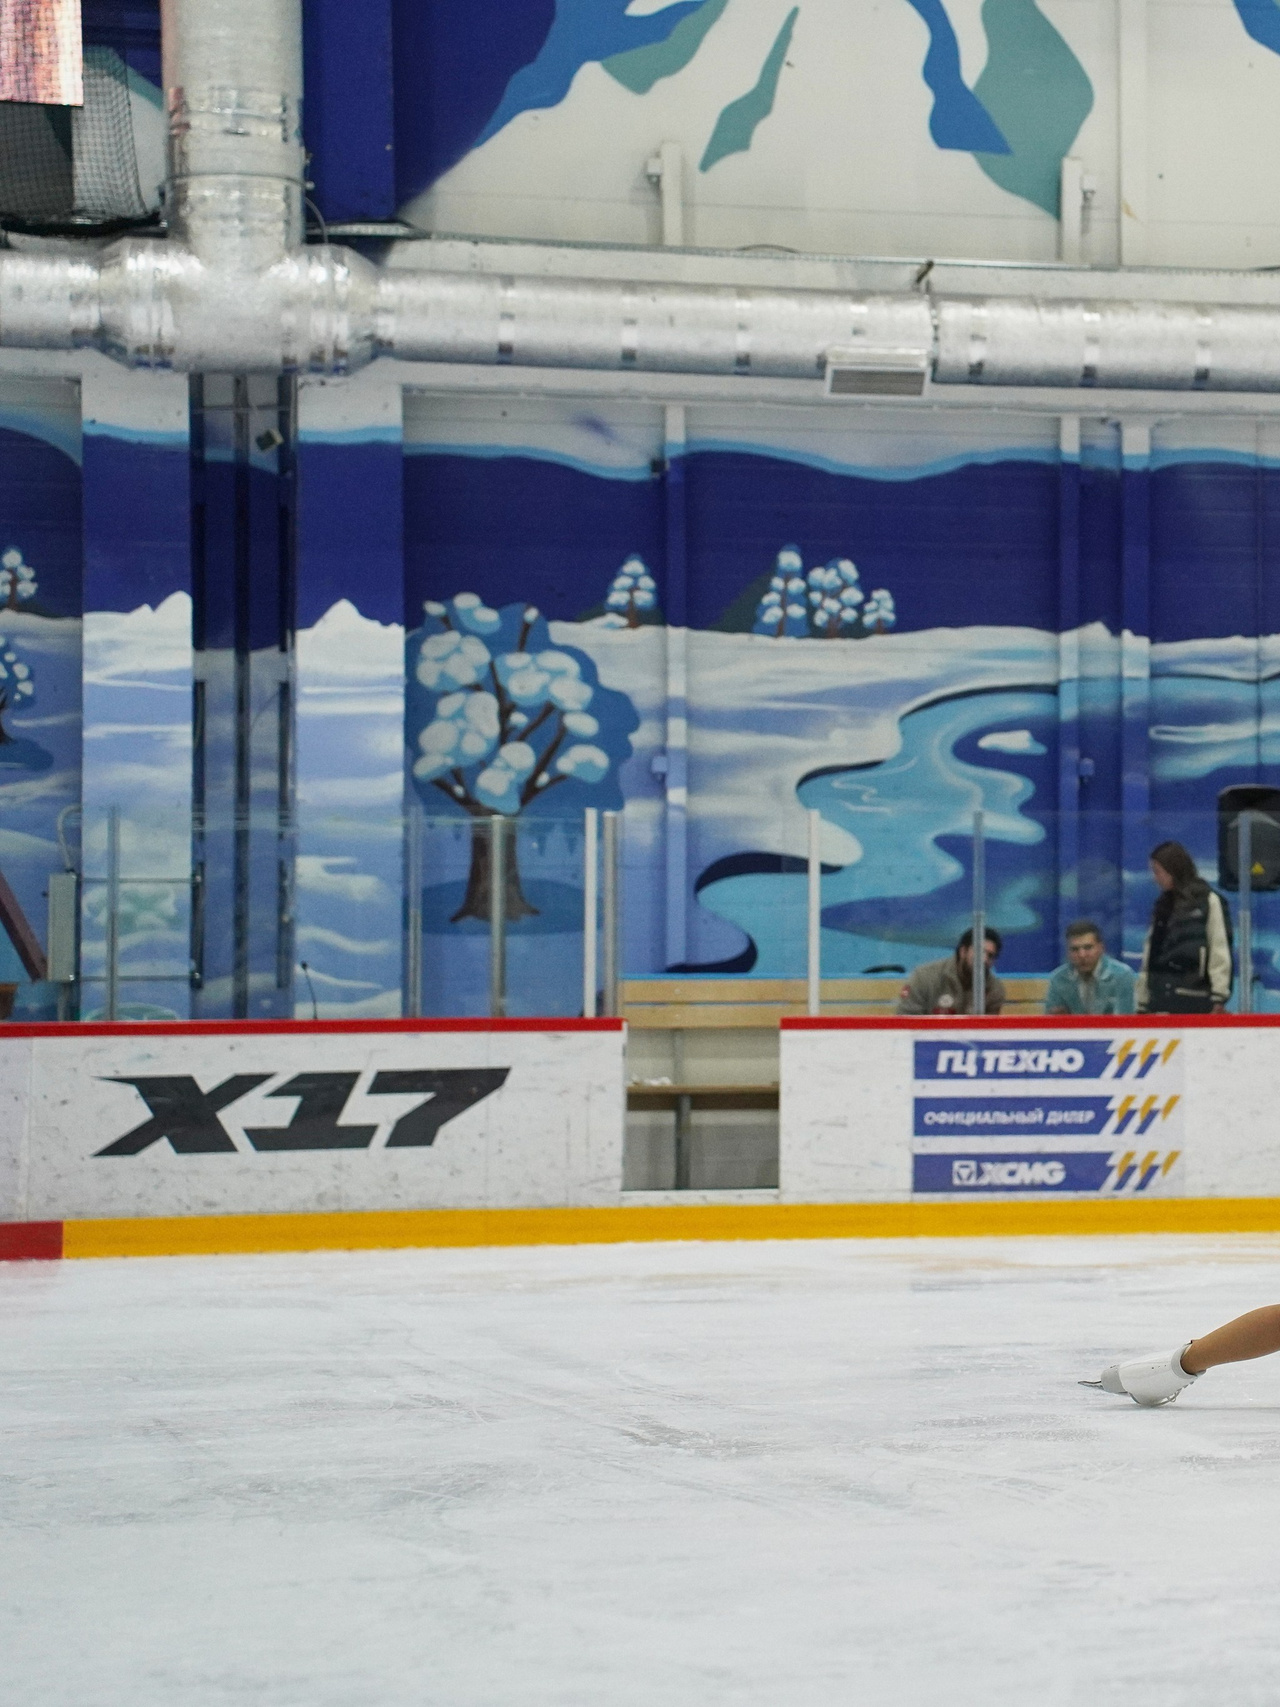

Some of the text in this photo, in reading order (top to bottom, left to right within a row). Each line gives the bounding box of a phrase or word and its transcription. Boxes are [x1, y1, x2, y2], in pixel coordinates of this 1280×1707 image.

[936, 1048, 1085, 1077] ГЦ ТЕХНО
[91, 1066, 512, 1157] X17
[923, 1107, 1096, 1126] ОФИЦИАЛЬНЫЙ ДИЛЕР
[977, 1161, 1067, 1185] XCMG
